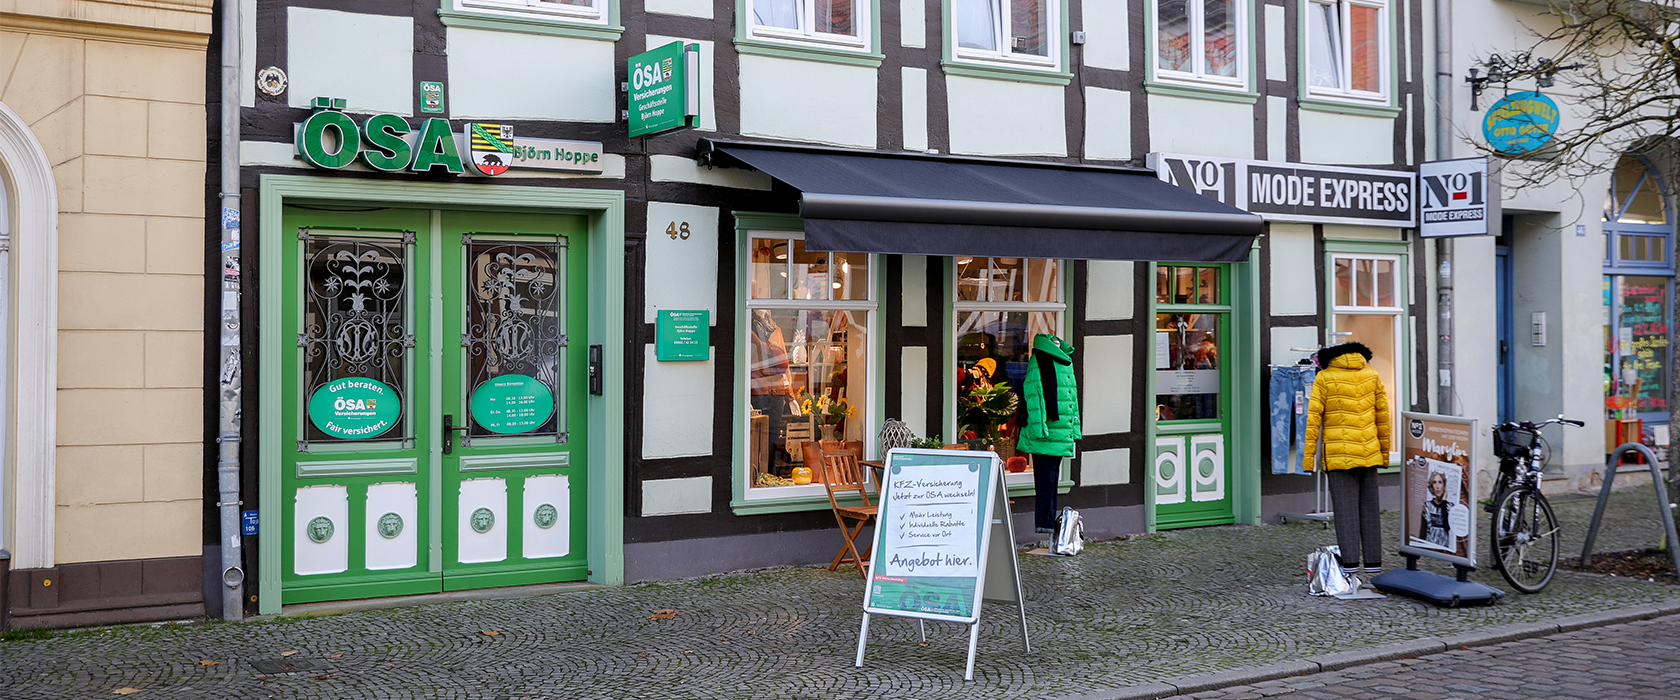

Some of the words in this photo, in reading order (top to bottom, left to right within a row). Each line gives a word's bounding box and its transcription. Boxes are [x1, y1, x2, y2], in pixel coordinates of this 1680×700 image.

[633, 62, 662, 90] ÖSA
[423, 83, 441, 93] ÖSA
[633, 84, 673, 101] Versicherungen
[298, 96, 464, 174] ÖSA
[1493, 126, 1517, 137] OTTO
[514, 145, 551, 162] Björn
[555, 147, 599, 165] Hoppe
[1251, 172, 1315, 206] MODE
[1319, 177, 1409, 213] EXPRESS
[1425, 211, 1448, 221] MODE
[1449, 209, 1483, 220] EXPRESS
[666, 221, 690, 240] 48
[329, 382, 346, 393] Gut
[348, 380, 384, 395] beraten.
[334, 397, 366, 411] ÖSA
[326, 421, 342, 433] Fair
[343, 420, 388, 435] versichert.
[893, 478, 963, 489] KFZ-Versicherung
[892, 491, 911, 500] Jetzt
[944, 489, 976, 498] wechseln!
[926, 511, 952, 519] Leistung
[889, 551, 943, 572] Angebot
[945, 554, 972, 566] hier.
[899, 584, 963, 614] ÖSA
